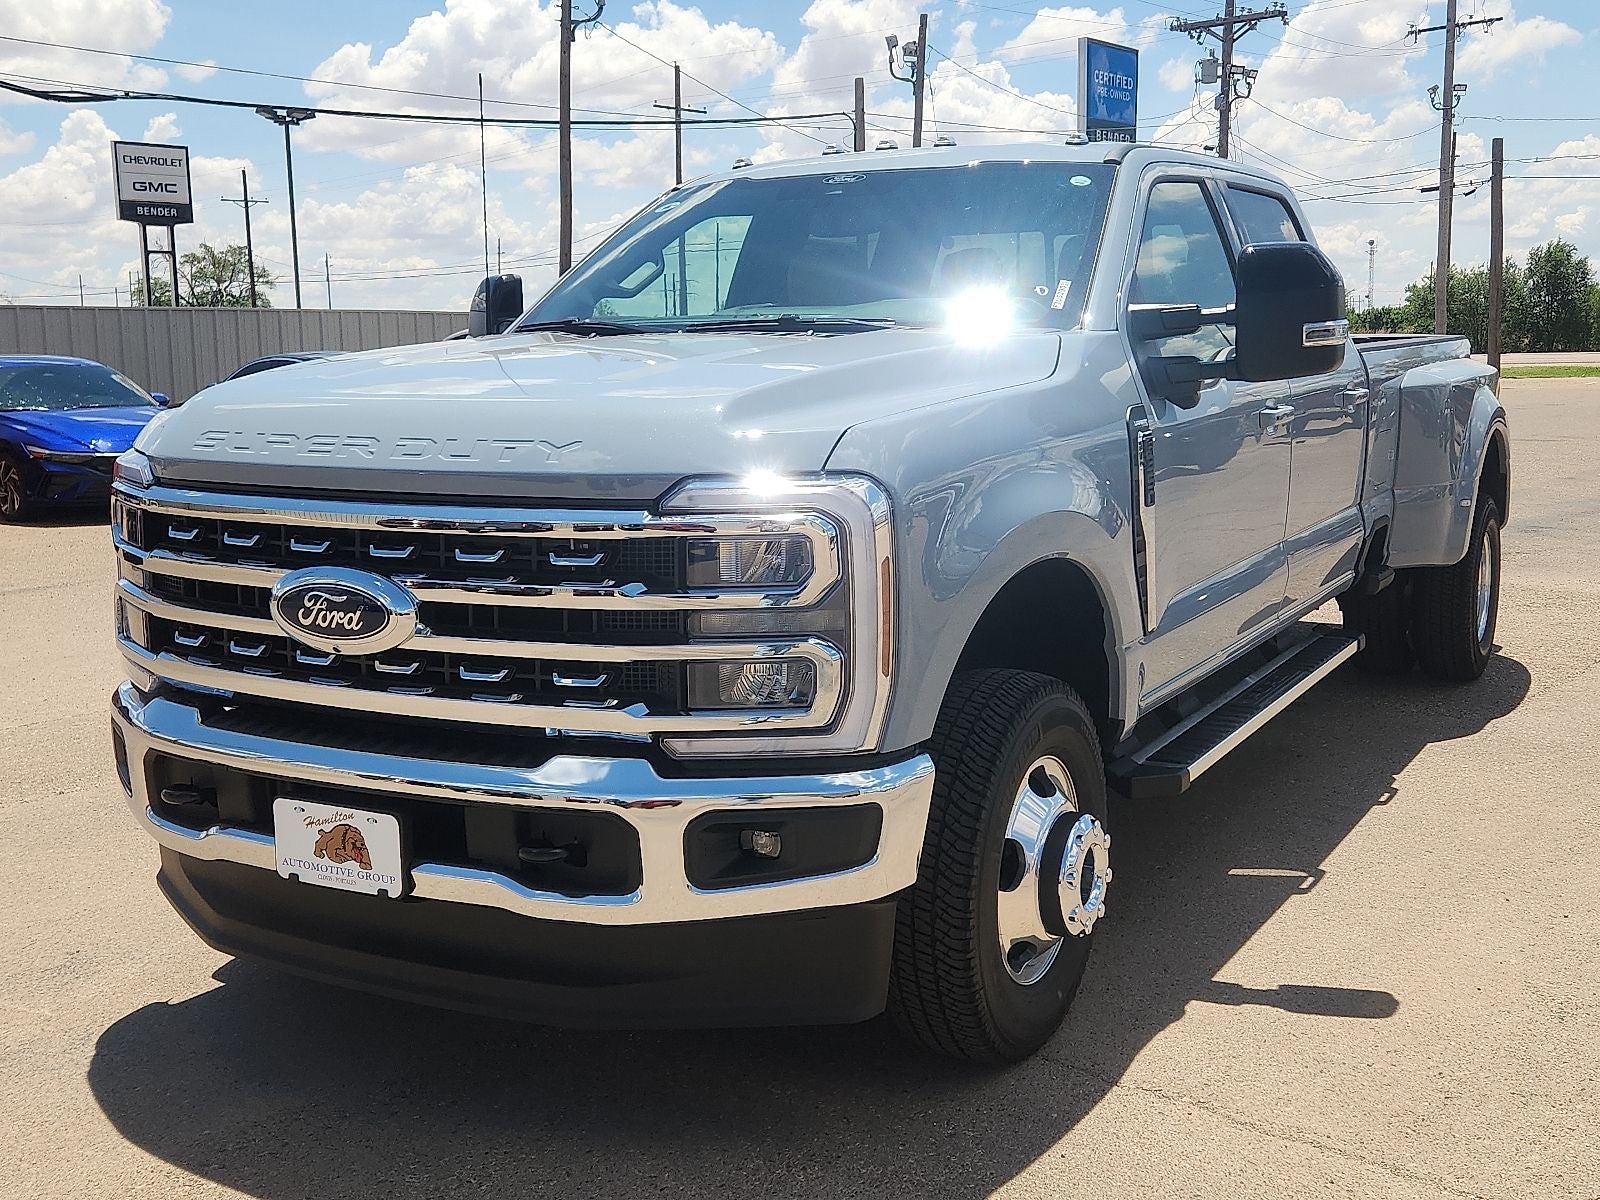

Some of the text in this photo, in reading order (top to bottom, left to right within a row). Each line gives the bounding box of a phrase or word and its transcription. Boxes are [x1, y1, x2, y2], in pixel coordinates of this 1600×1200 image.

[1094, 69, 1133, 89] CERTIFIED
[1096, 85, 1131, 101] PRE-OWNED
[123, 155, 183, 167] CHEVROLET
[132, 181, 178, 193] GMC
[136, 206, 177, 217] BENDER
[191, 430, 583, 464] SUPER DUTY
[298, 591, 363, 631] Ford
[303, 811, 355, 829] Hamilton
[282, 858, 396, 885] AUTOMOTIVE GROUP
